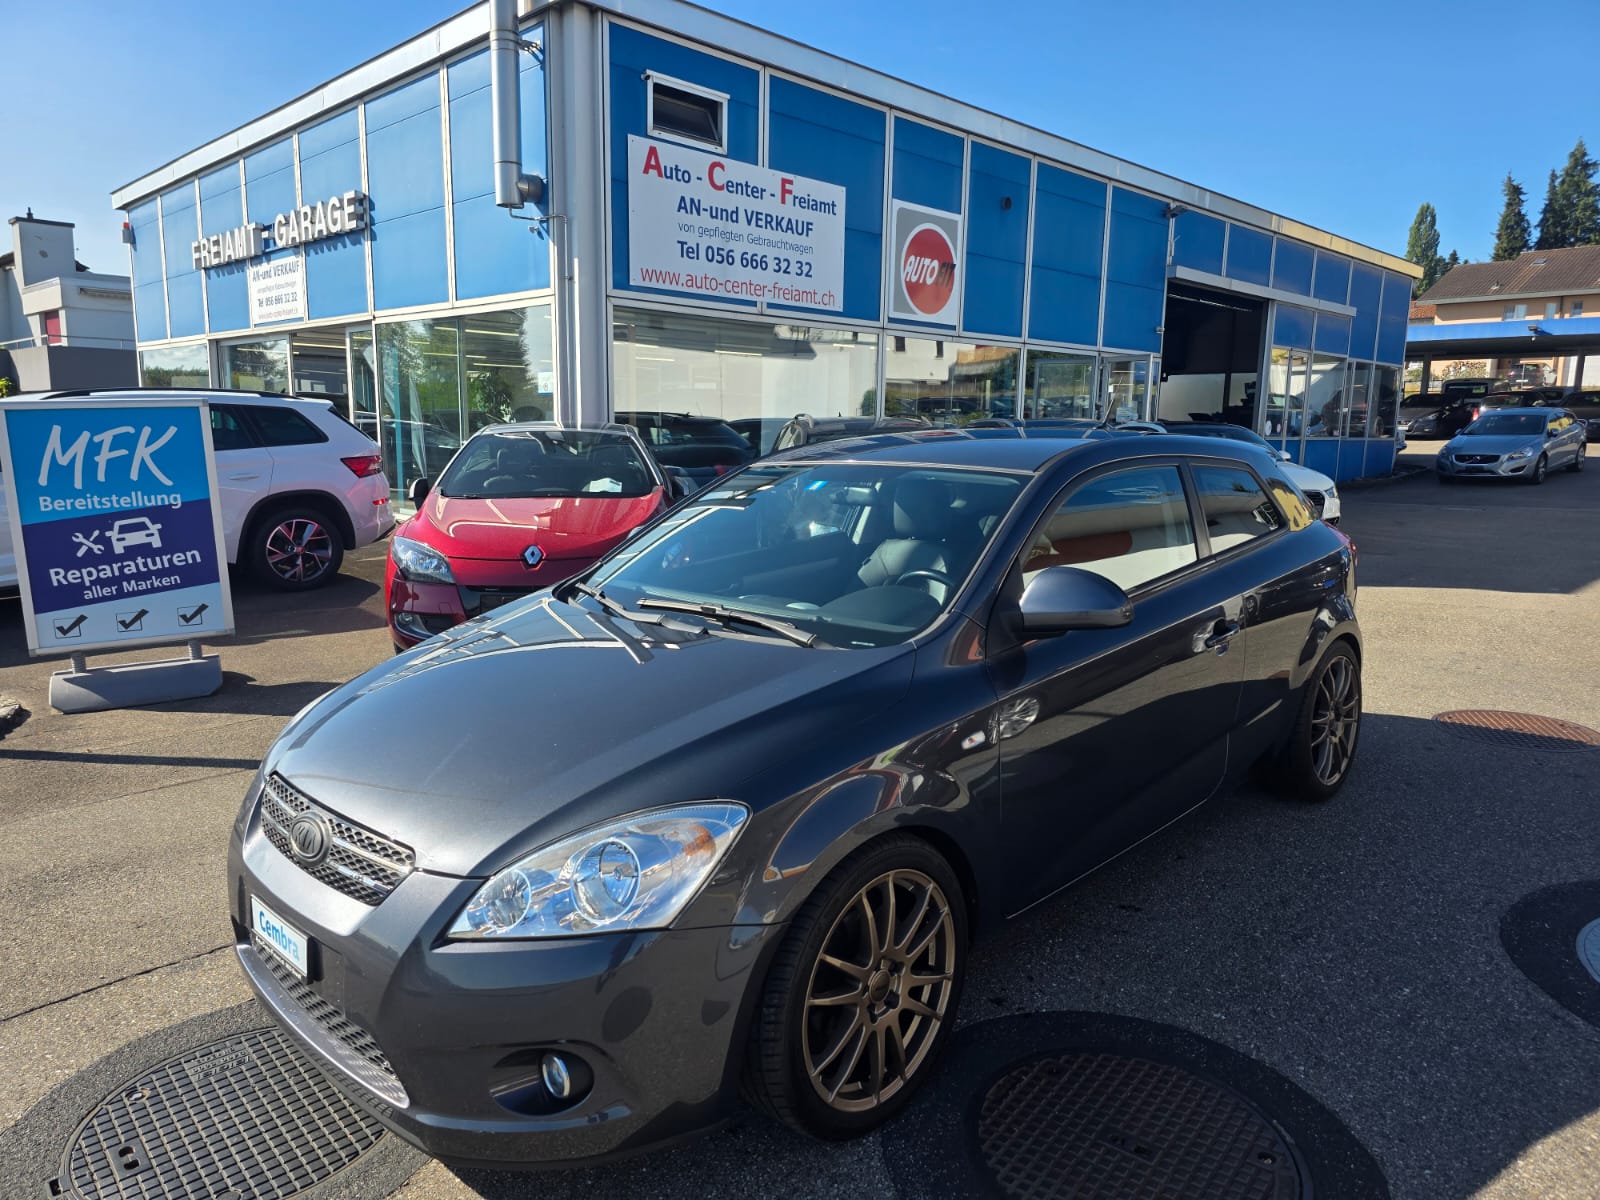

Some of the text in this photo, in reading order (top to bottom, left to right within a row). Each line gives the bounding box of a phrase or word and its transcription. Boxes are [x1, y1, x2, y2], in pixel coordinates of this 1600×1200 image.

[643, 145, 691, 184] Auto
[708, 161, 767, 201] Center
[781, 177, 837, 216] Freiamt
[191, 221, 260, 270] FREIAMT
[274, 190, 361, 247] GARAGE
[677, 195, 814, 238] AN-und VERKAUF
[678, 222, 814, 255] von gepflegten Gebrauchtwagen
[273, 260, 300, 277] VERKAUF
[677, 240, 813, 278] Tel 056 666 32 32
[640, 267, 835, 307] www.auto-center-freiamt.ch
[38, 424, 178, 489] MFK
[38, 490, 182, 512] Bereitstellung
[49, 549, 201, 588] Reparaturen
[83, 573, 181, 600] aller Marken
[259, 910, 299, 961] Cembra
